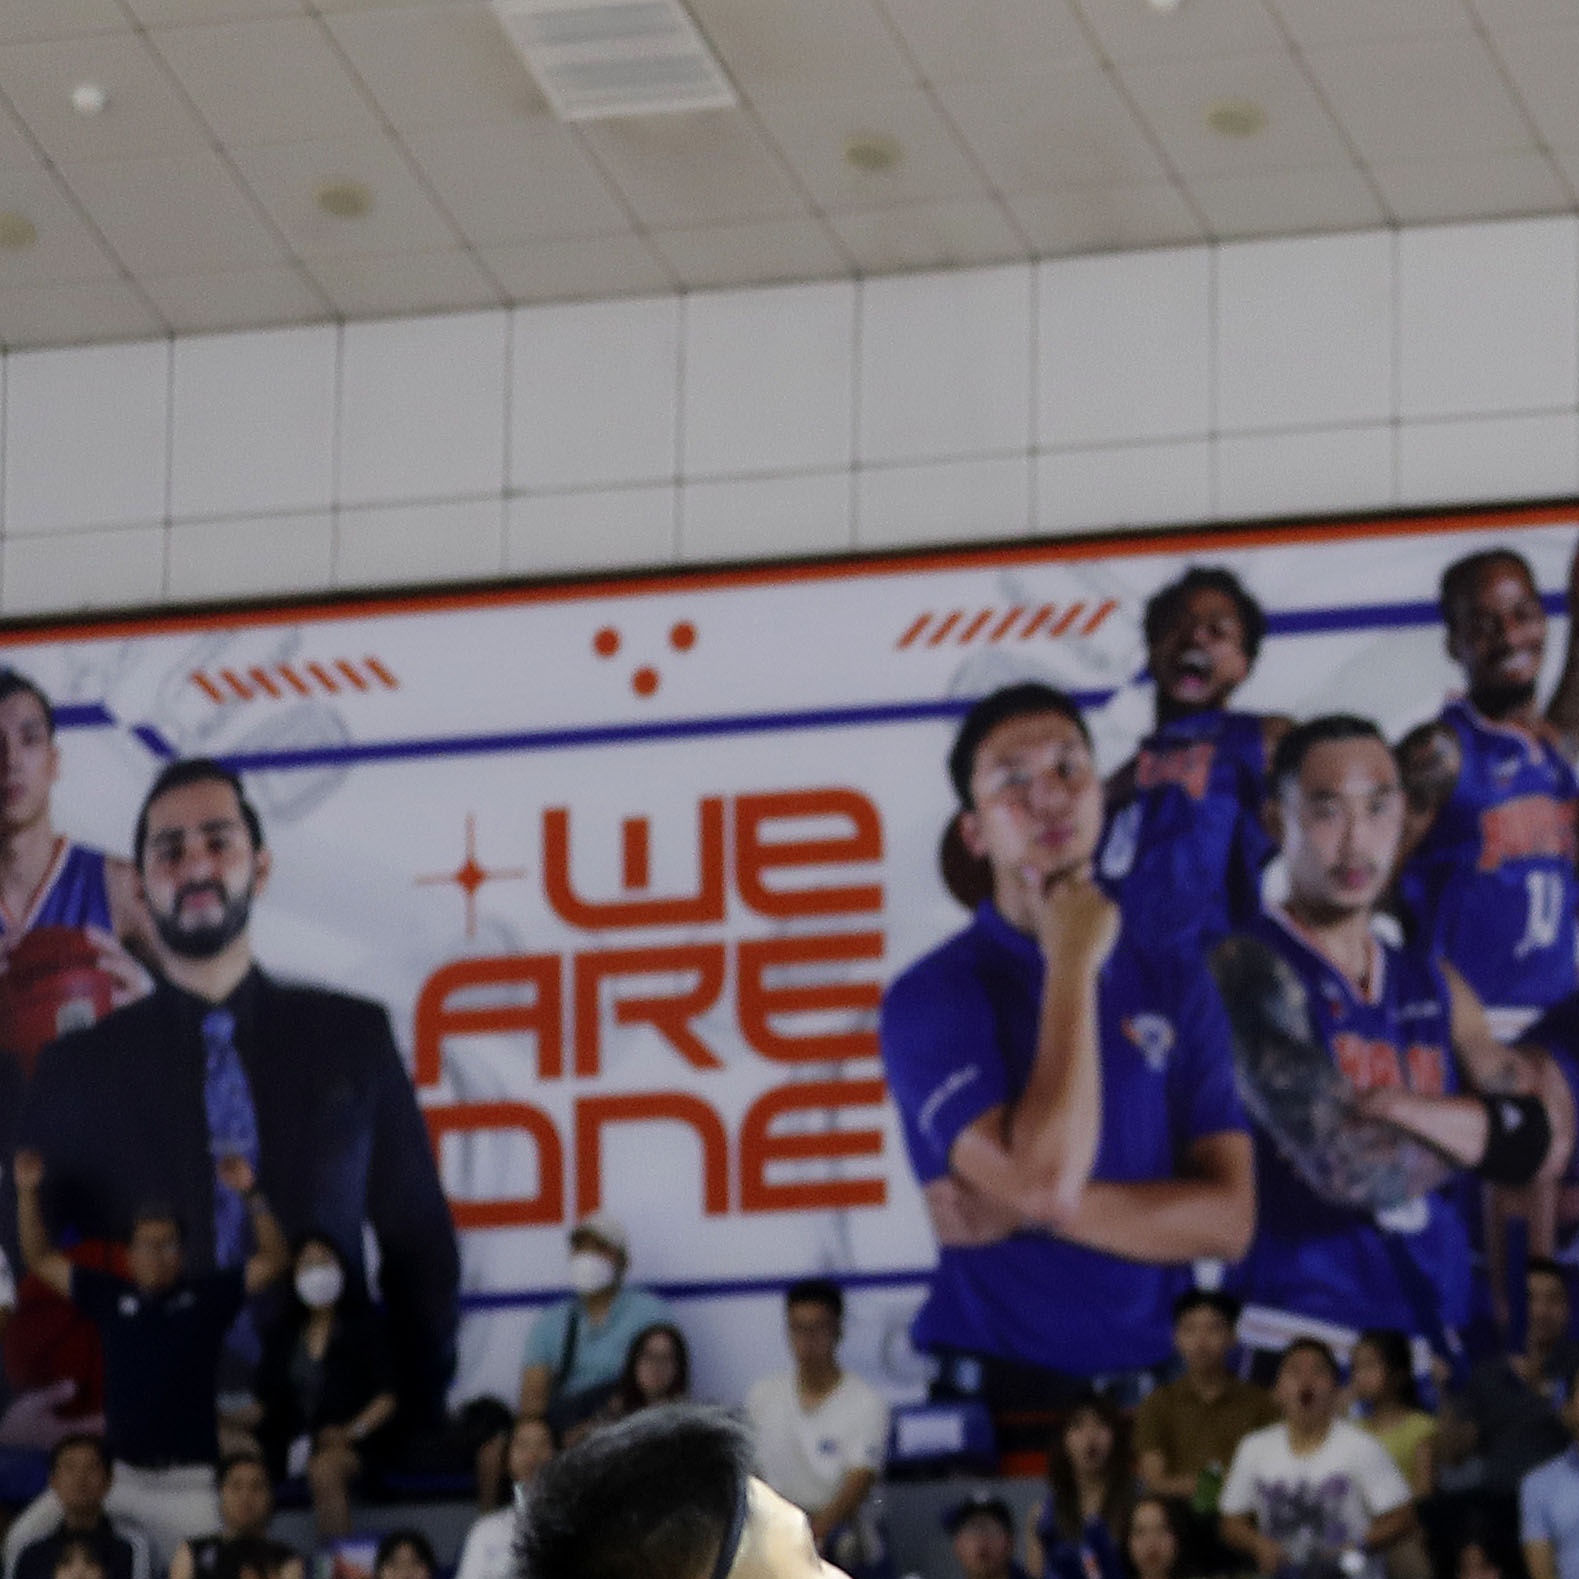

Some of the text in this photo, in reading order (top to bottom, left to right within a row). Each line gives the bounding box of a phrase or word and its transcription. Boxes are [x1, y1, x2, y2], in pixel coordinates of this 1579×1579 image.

[542, 787, 884, 931] WE
[413, 931, 886, 1087] ARE
[427, 1078, 888, 1230] ONE
